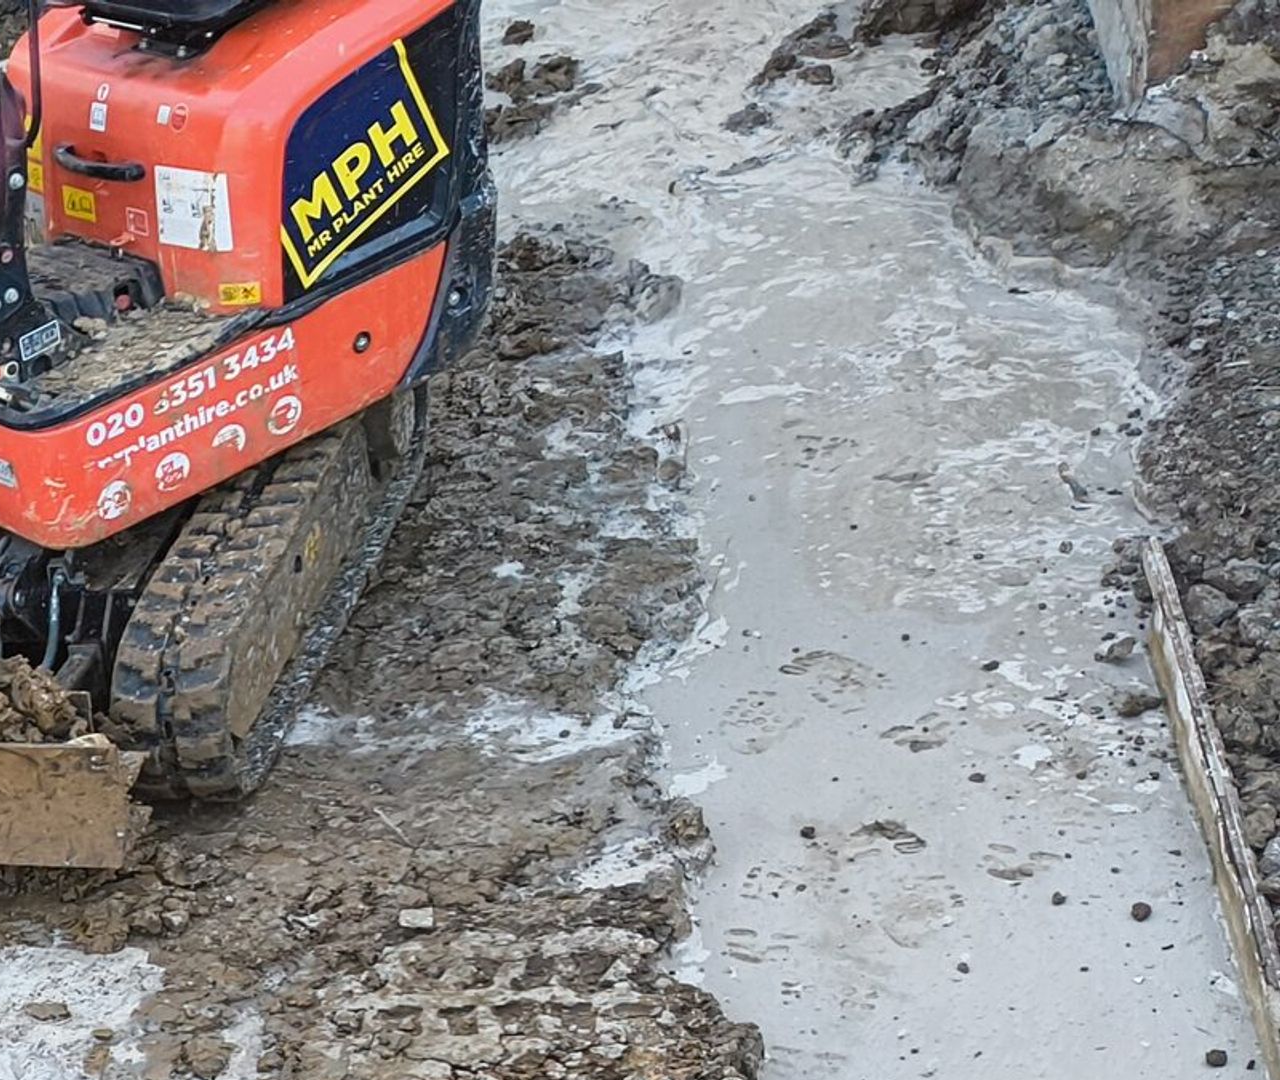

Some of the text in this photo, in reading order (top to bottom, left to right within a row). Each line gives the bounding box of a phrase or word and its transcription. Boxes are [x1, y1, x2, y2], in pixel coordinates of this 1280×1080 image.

[290, 100, 418, 244] MPH
[307, 142, 426, 258] MR PLANT HIRE
[86, 403, 145, 446] 020
[223, 327, 295, 380] 3434
